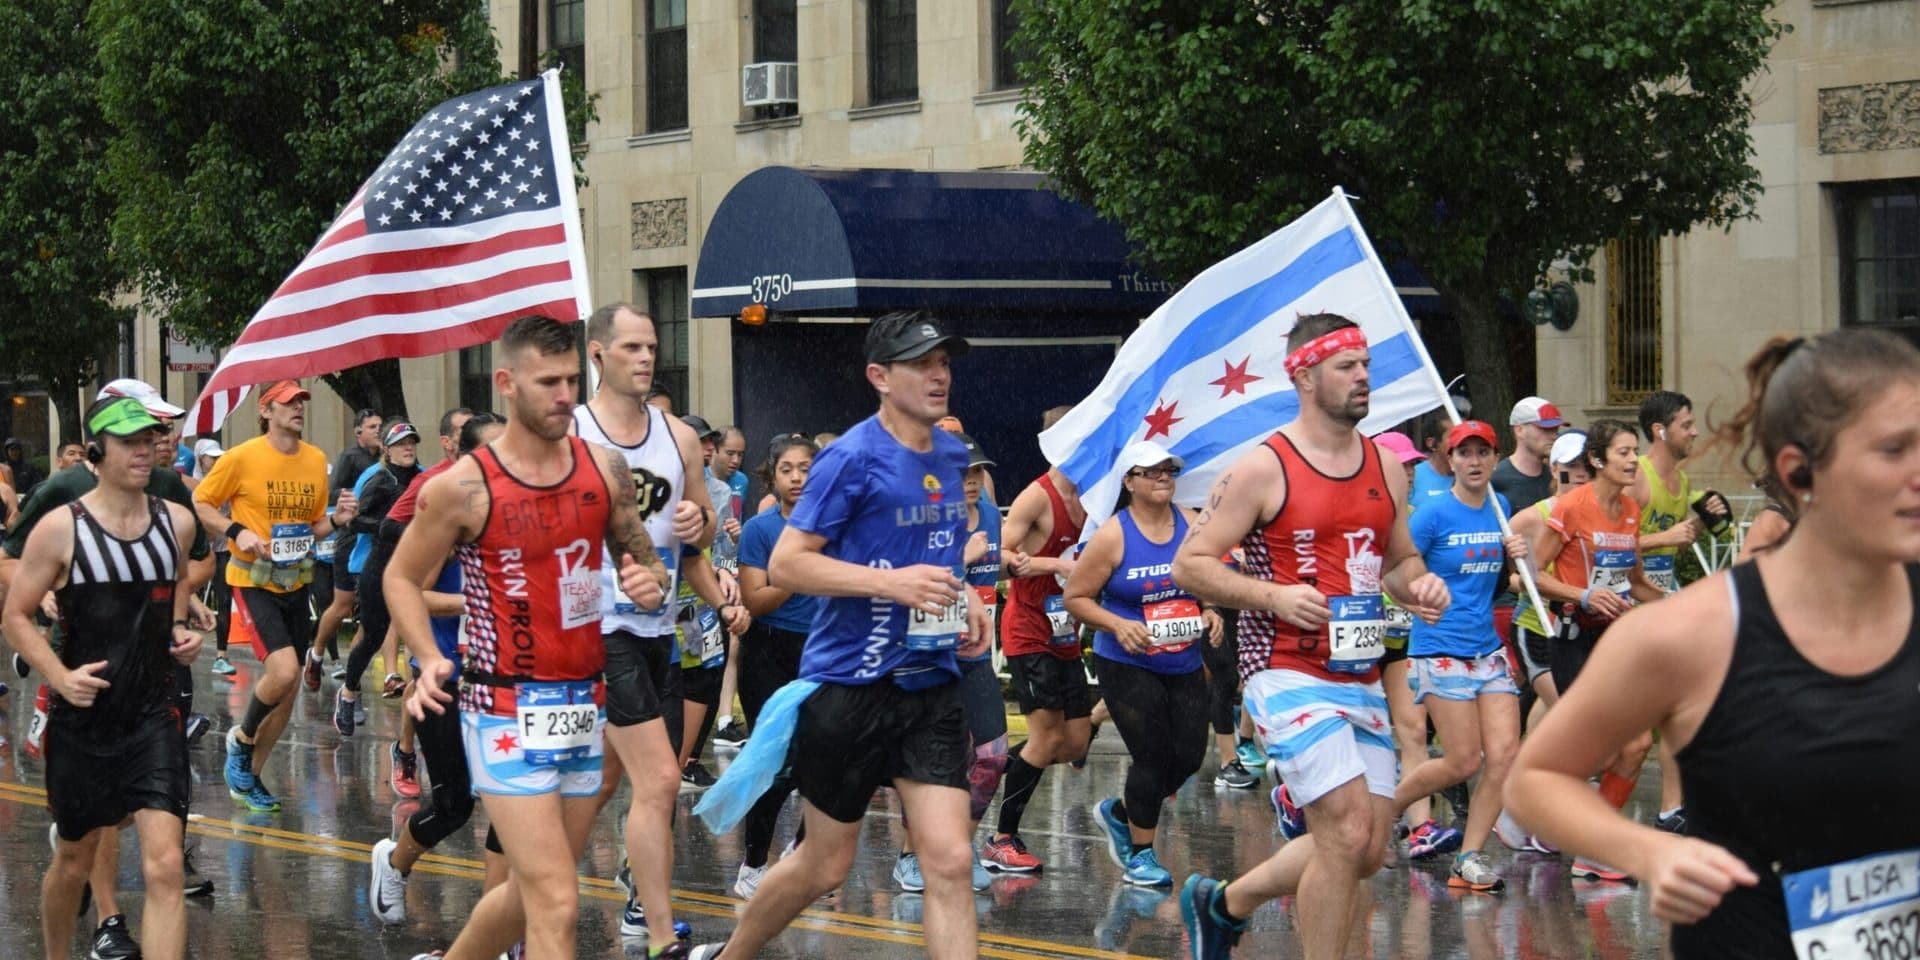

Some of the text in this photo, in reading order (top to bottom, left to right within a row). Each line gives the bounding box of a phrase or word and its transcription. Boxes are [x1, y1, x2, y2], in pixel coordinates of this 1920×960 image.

[752, 273, 792, 303] 3750
[173, 363, 211, 371] TOW ZONE
[266, 481, 315, 493] MISSION
[502, 488, 580, 535] BRETT
[896, 505, 940, 527] LUIS
[273, 542, 280, 554] G
[1593, 571, 1603, 584] F
[1152, 620, 1200, 639] C 19014
[1335, 627, 1345, 649] F
[524, 710, 596, 736] F 23346
[1845, 863, 1904, 903] LISA
